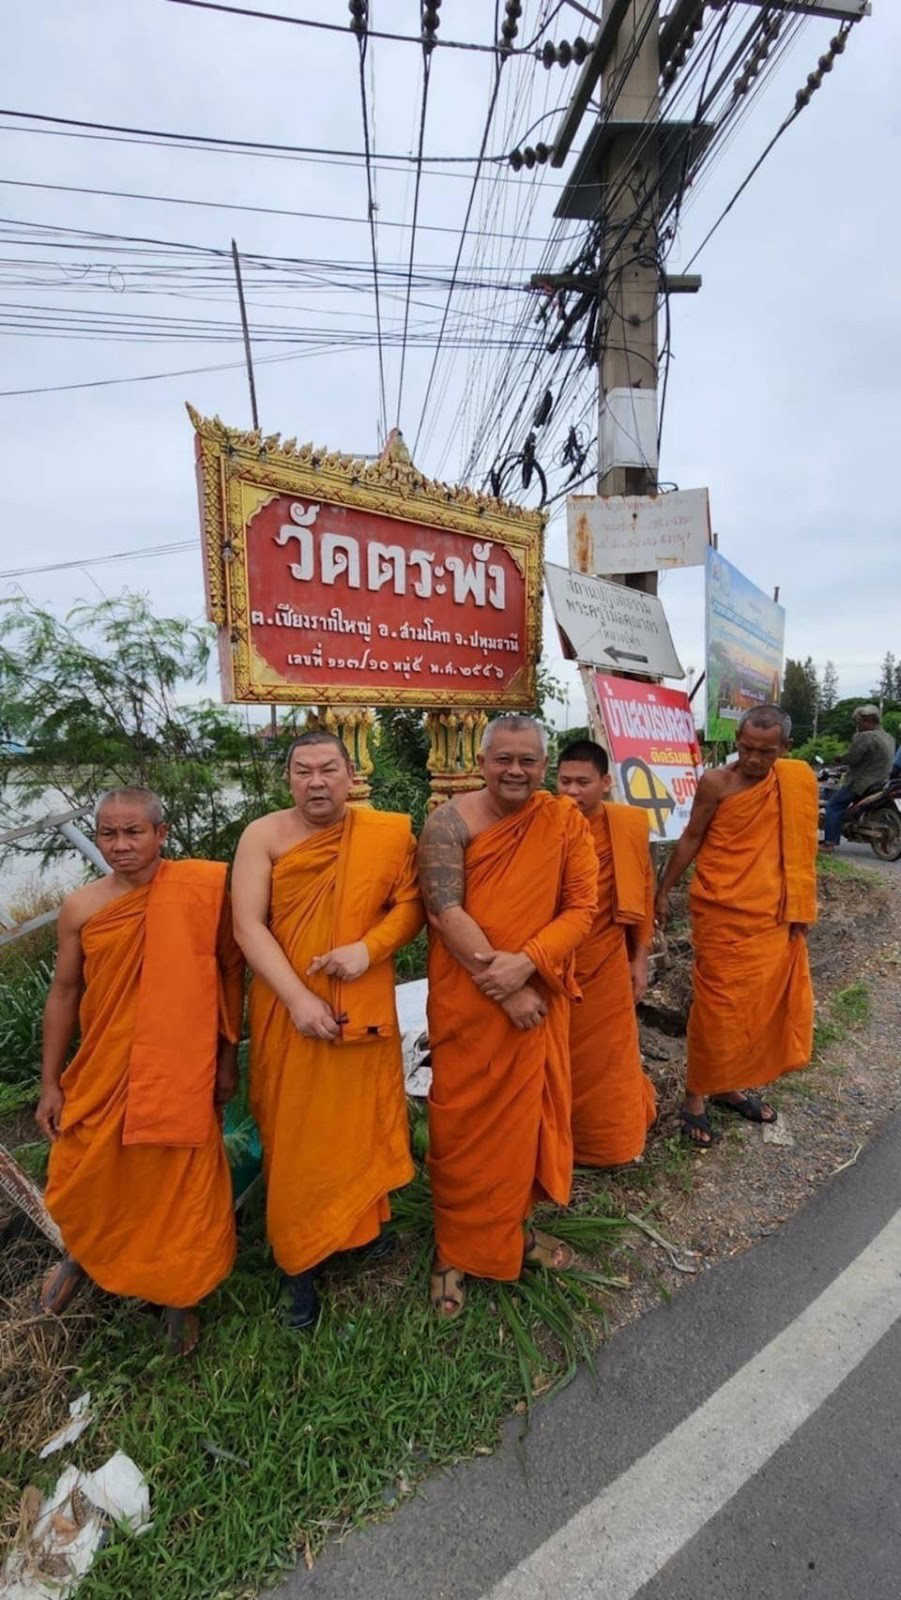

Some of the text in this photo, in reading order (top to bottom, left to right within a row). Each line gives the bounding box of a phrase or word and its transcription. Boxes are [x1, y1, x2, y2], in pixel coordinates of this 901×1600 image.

[272, 502, 505, 610] วัดตระพัง
[251, 603, 519, 656] ต.เชียงรากใหญ่ อ.สามโคก จ.ปทุมธานี
[288, 642, 323, 667] เลขที่
